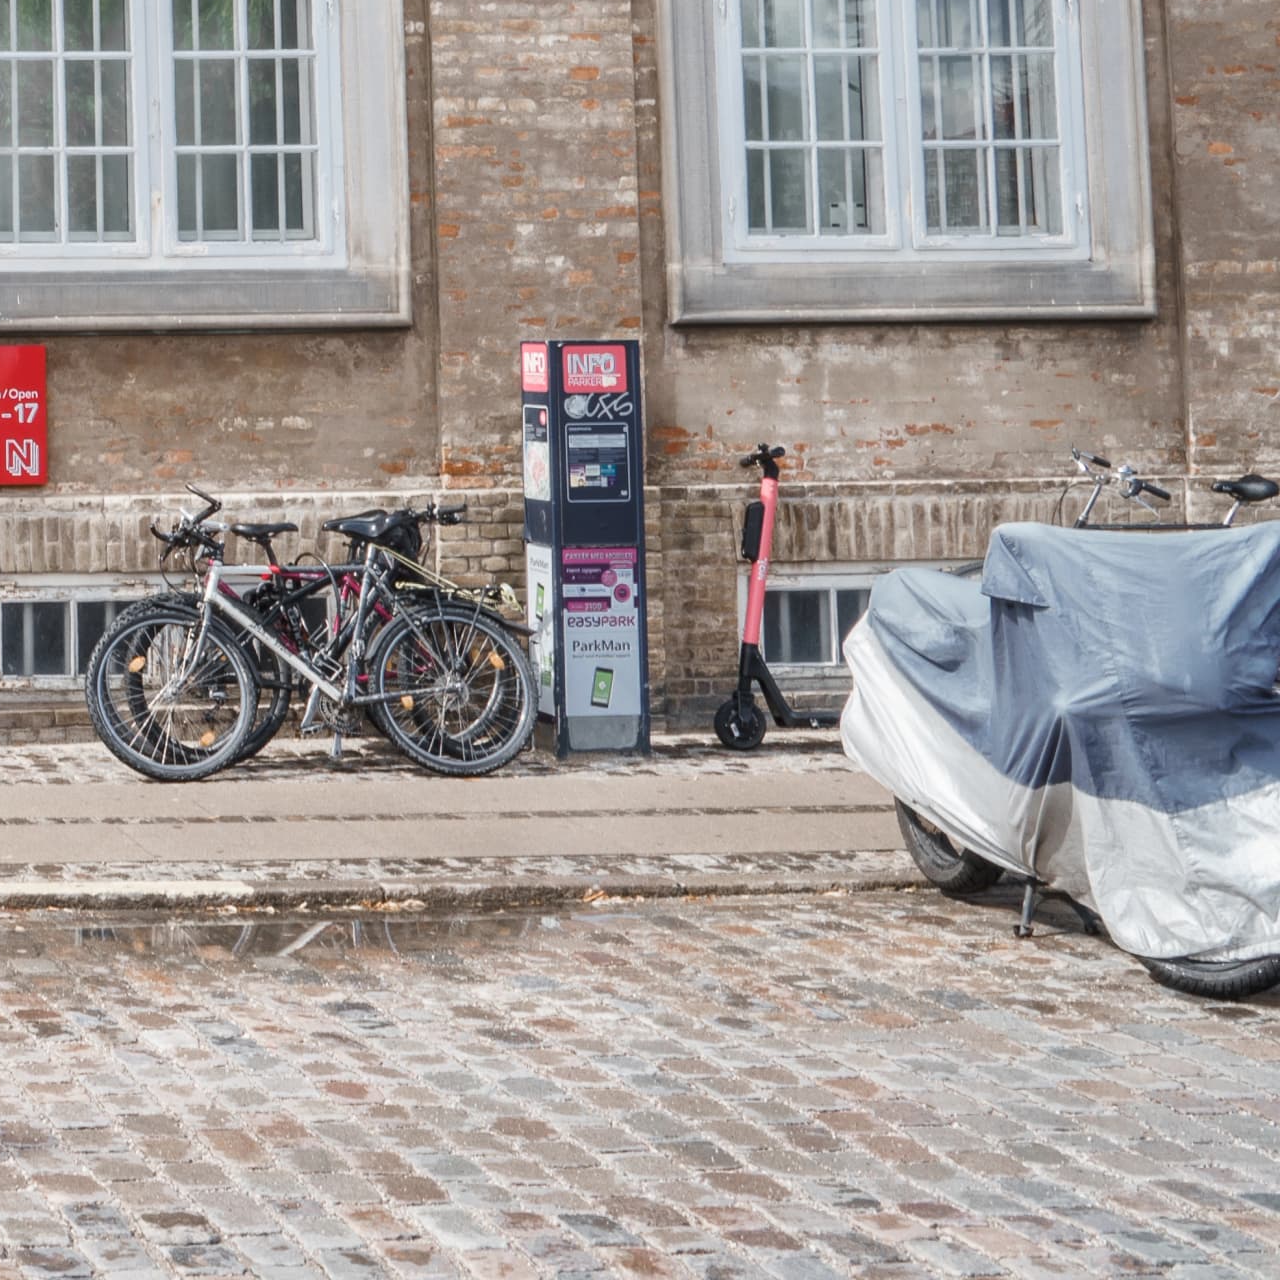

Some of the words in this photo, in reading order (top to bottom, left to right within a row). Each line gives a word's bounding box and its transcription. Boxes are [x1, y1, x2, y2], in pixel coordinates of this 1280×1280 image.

[524, 352, 545, 373] INFO
[567, 353, 615, 374] INFO
[8, 388, 39, 402] Open
[572, 639, 631, 652] ParkMan
